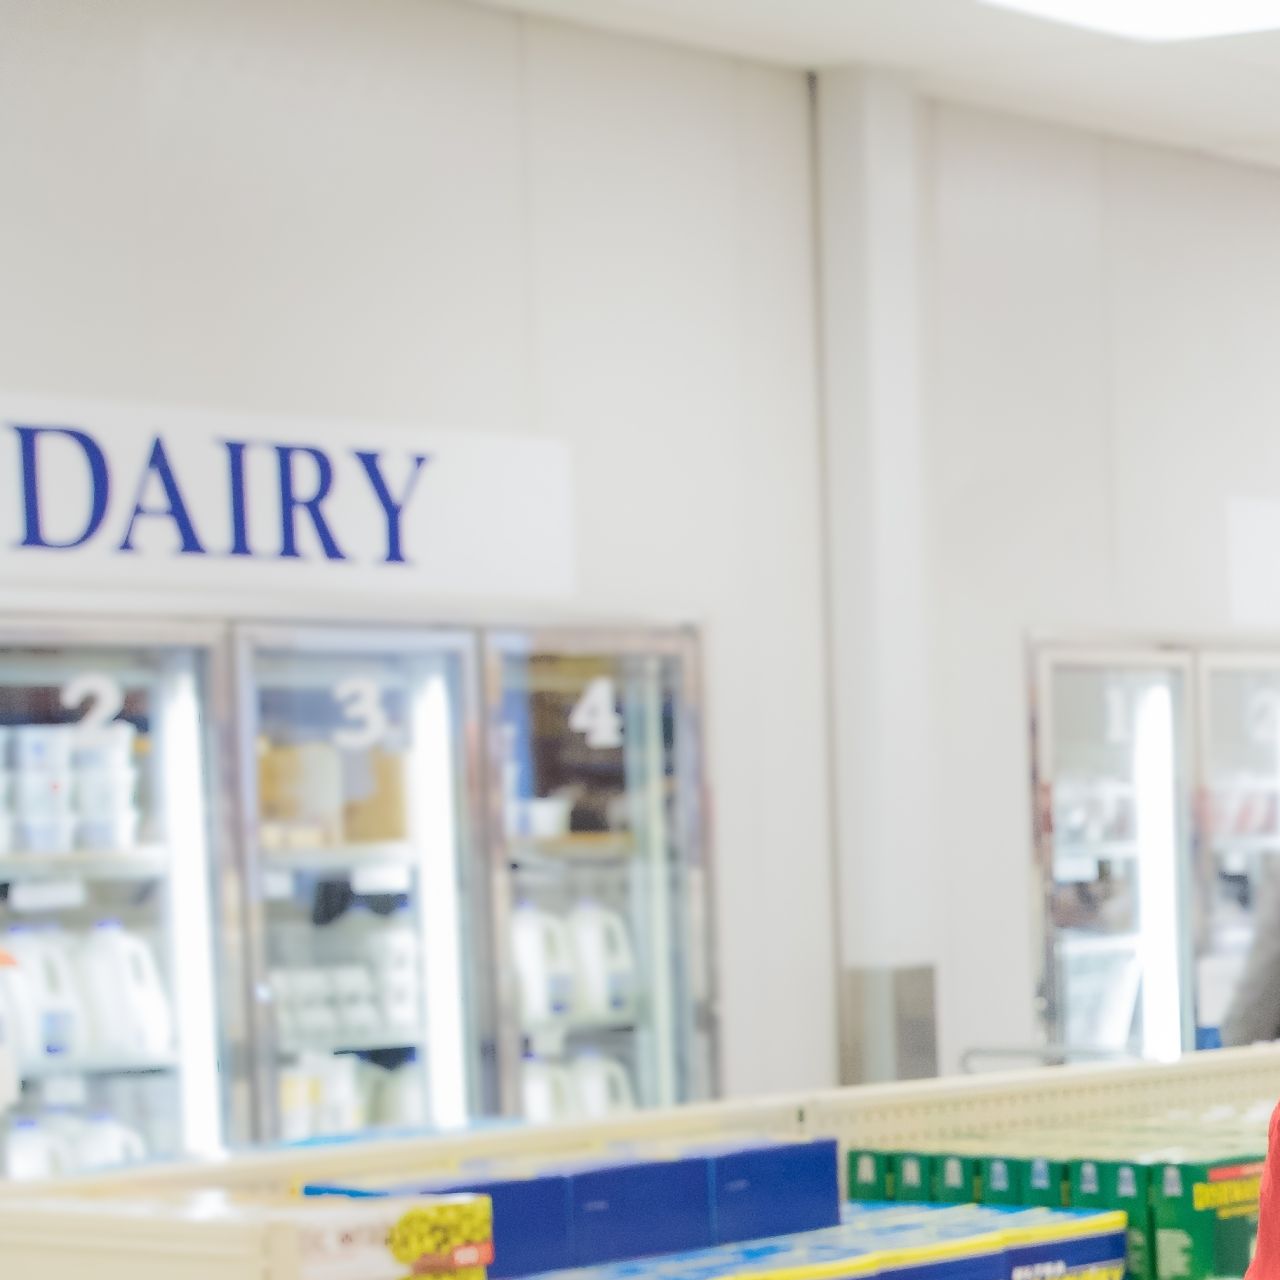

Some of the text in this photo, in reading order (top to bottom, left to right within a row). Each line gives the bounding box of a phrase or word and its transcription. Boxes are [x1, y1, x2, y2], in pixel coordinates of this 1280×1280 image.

[13, 425, 433, 565] DAIRY
[332, 679, 388, 749] 3
[570, 677, 626, 750] 4
